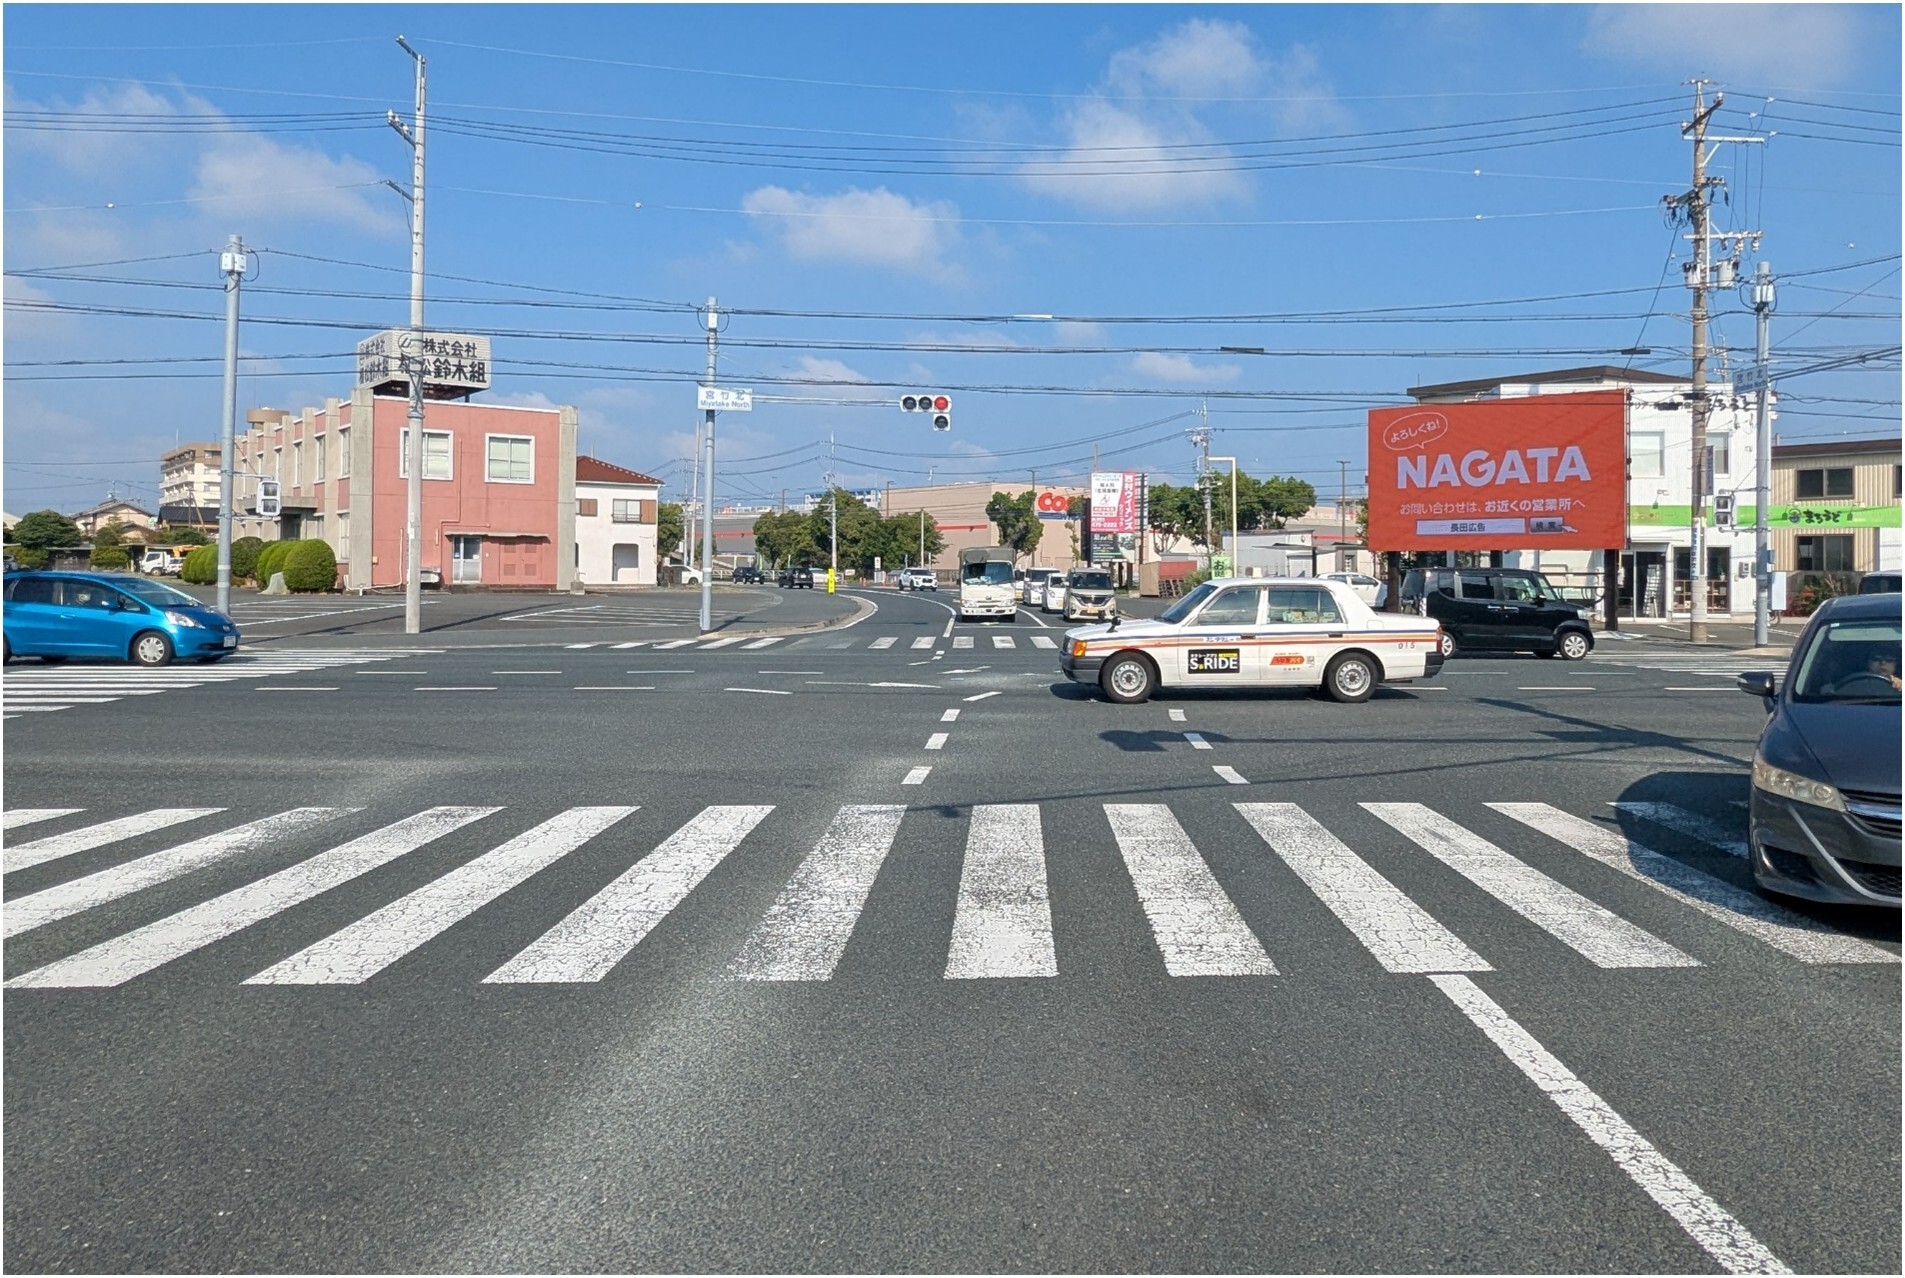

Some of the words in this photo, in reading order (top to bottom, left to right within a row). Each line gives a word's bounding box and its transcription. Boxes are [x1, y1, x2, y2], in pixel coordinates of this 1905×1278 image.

[422, 337, 478, 358] 株式会社
[705, 390, 745, 401] 宮竹北
[700, 400, 730, 408] Miyatake
[731, 400, 750, 408] North
[1397, 445, 1592, 489] NAGATA
[1399, 498, 1586, 515] お問い合わせは、お近くの営業所へ
[1450, 522, 1486, 533] 長田広告
[1190, 657, 1238, 670] S.RIDE
